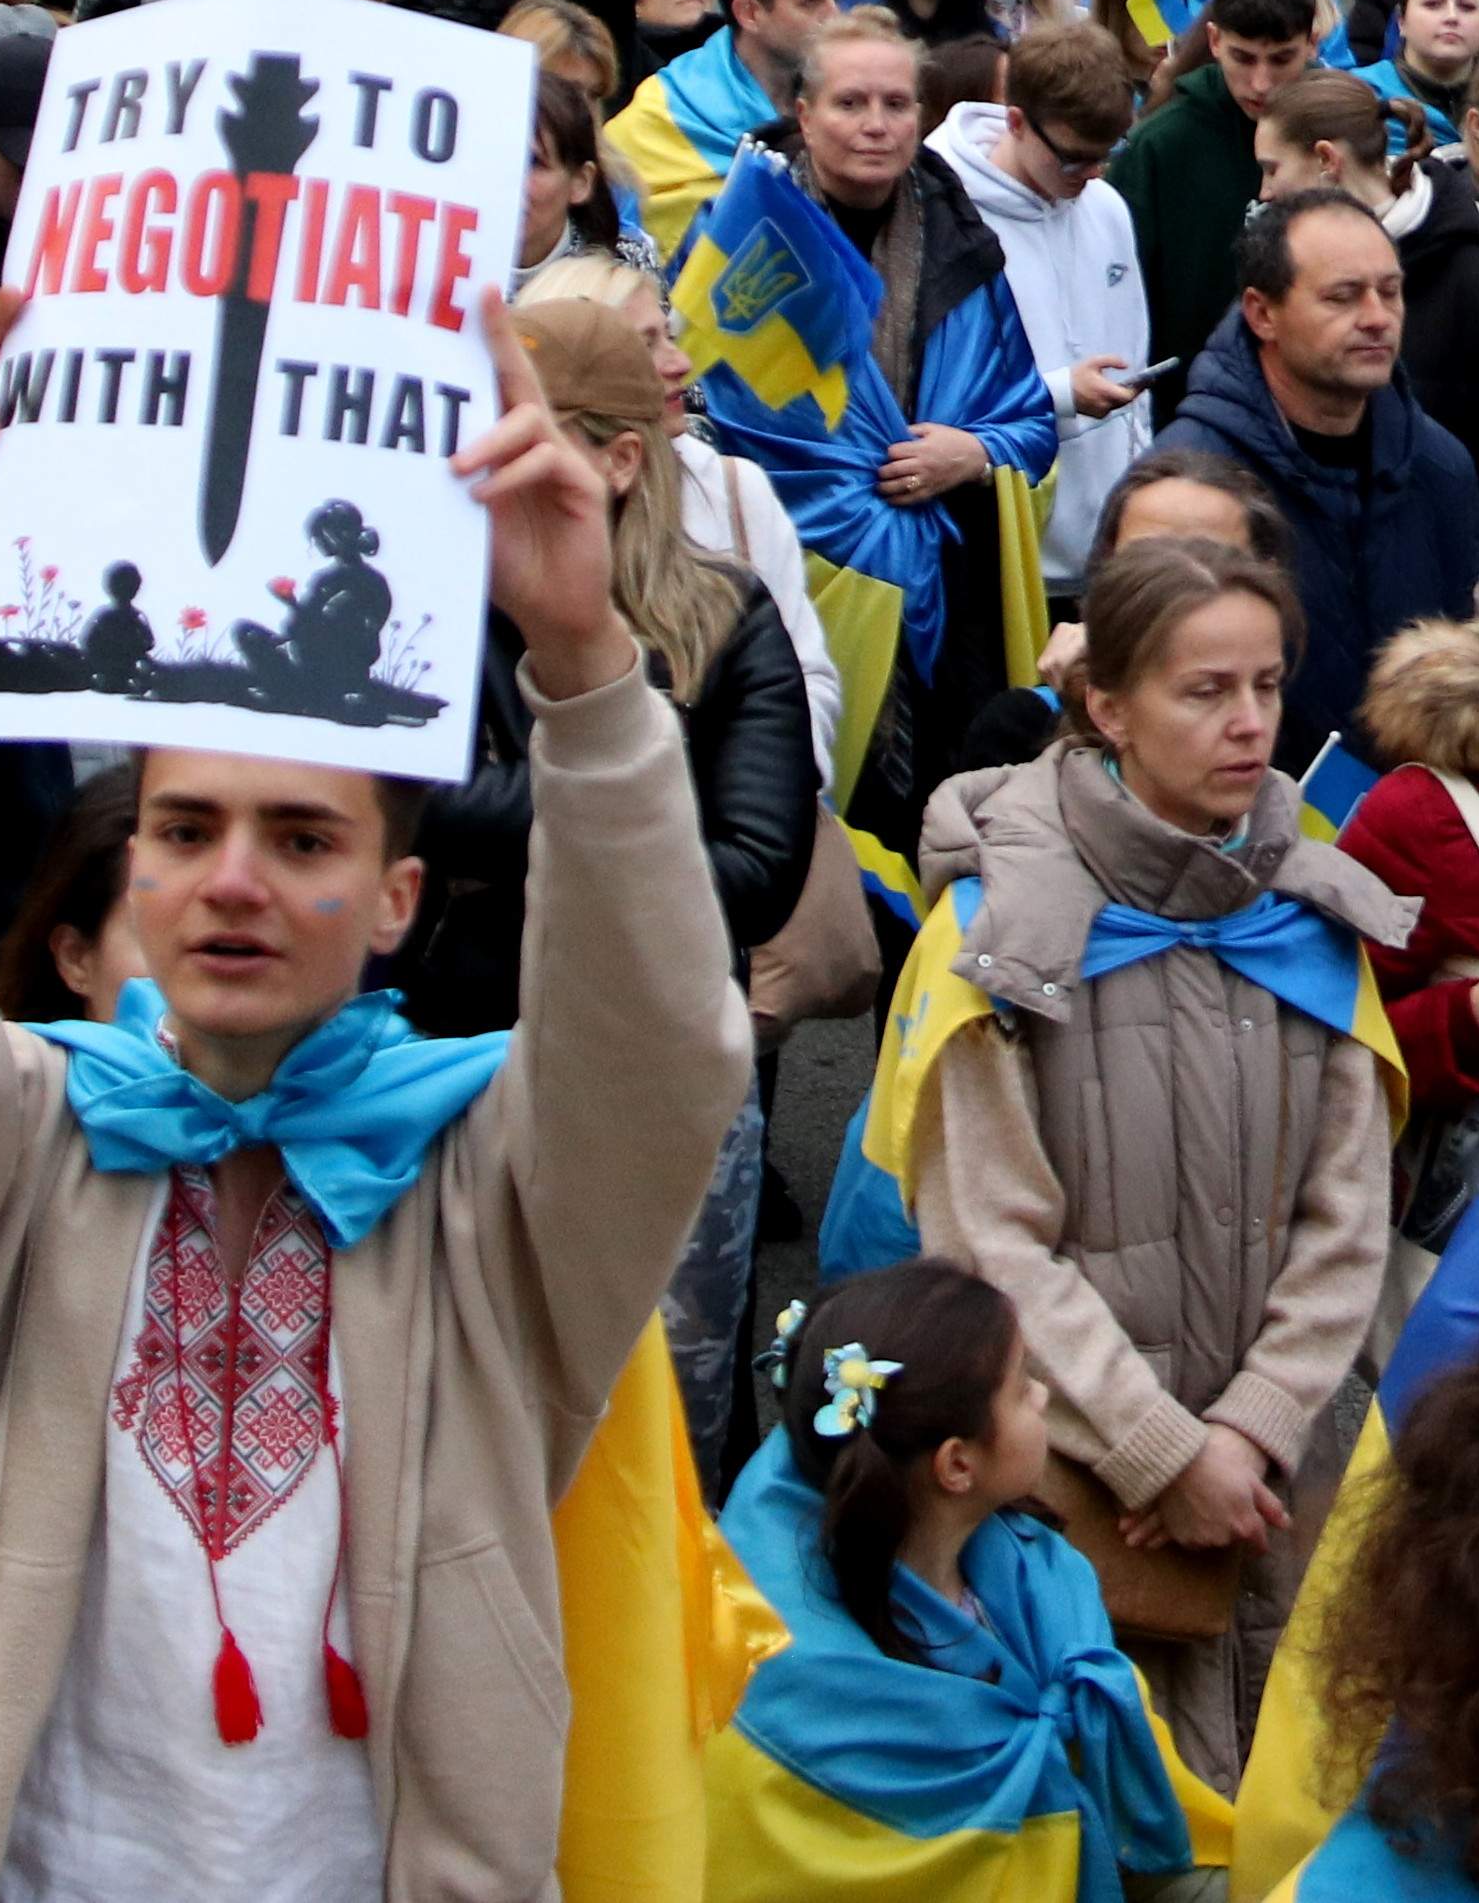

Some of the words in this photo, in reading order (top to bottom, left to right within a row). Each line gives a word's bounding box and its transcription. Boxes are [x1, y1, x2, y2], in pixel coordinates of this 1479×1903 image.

[60, 57, 210, 154] TRY
[347, 69, 459, 164] TO
[23, 167, 479, 334] NEGOTIATE
[274, 356, 471, 458] THAT
